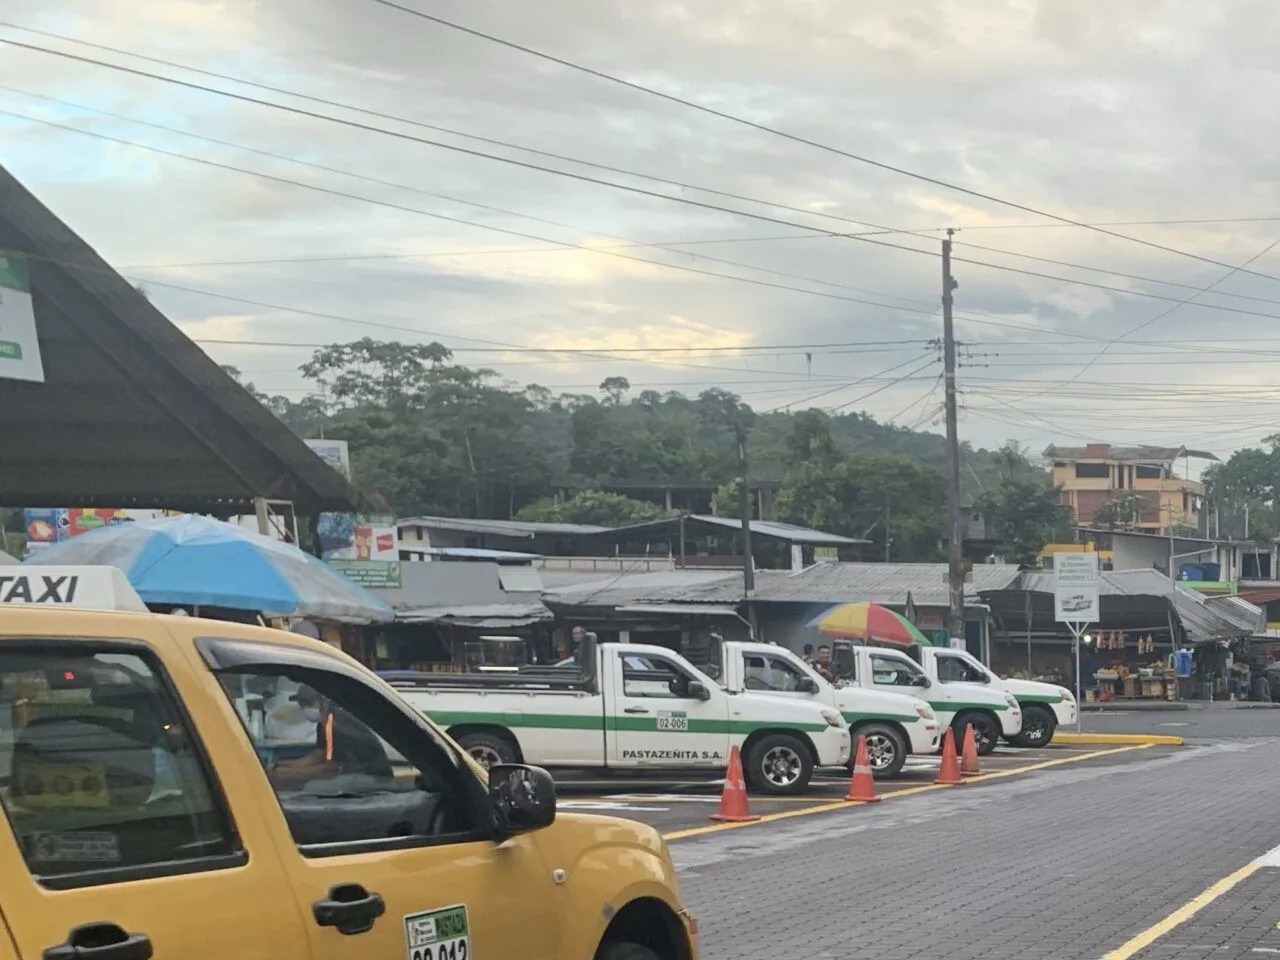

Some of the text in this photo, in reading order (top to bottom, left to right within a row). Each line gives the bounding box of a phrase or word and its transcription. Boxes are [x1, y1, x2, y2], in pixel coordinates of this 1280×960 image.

[660, 718, 686, 729] 02-006
[623, 749, 722, 759] PASTAZEÑITA S.A.
